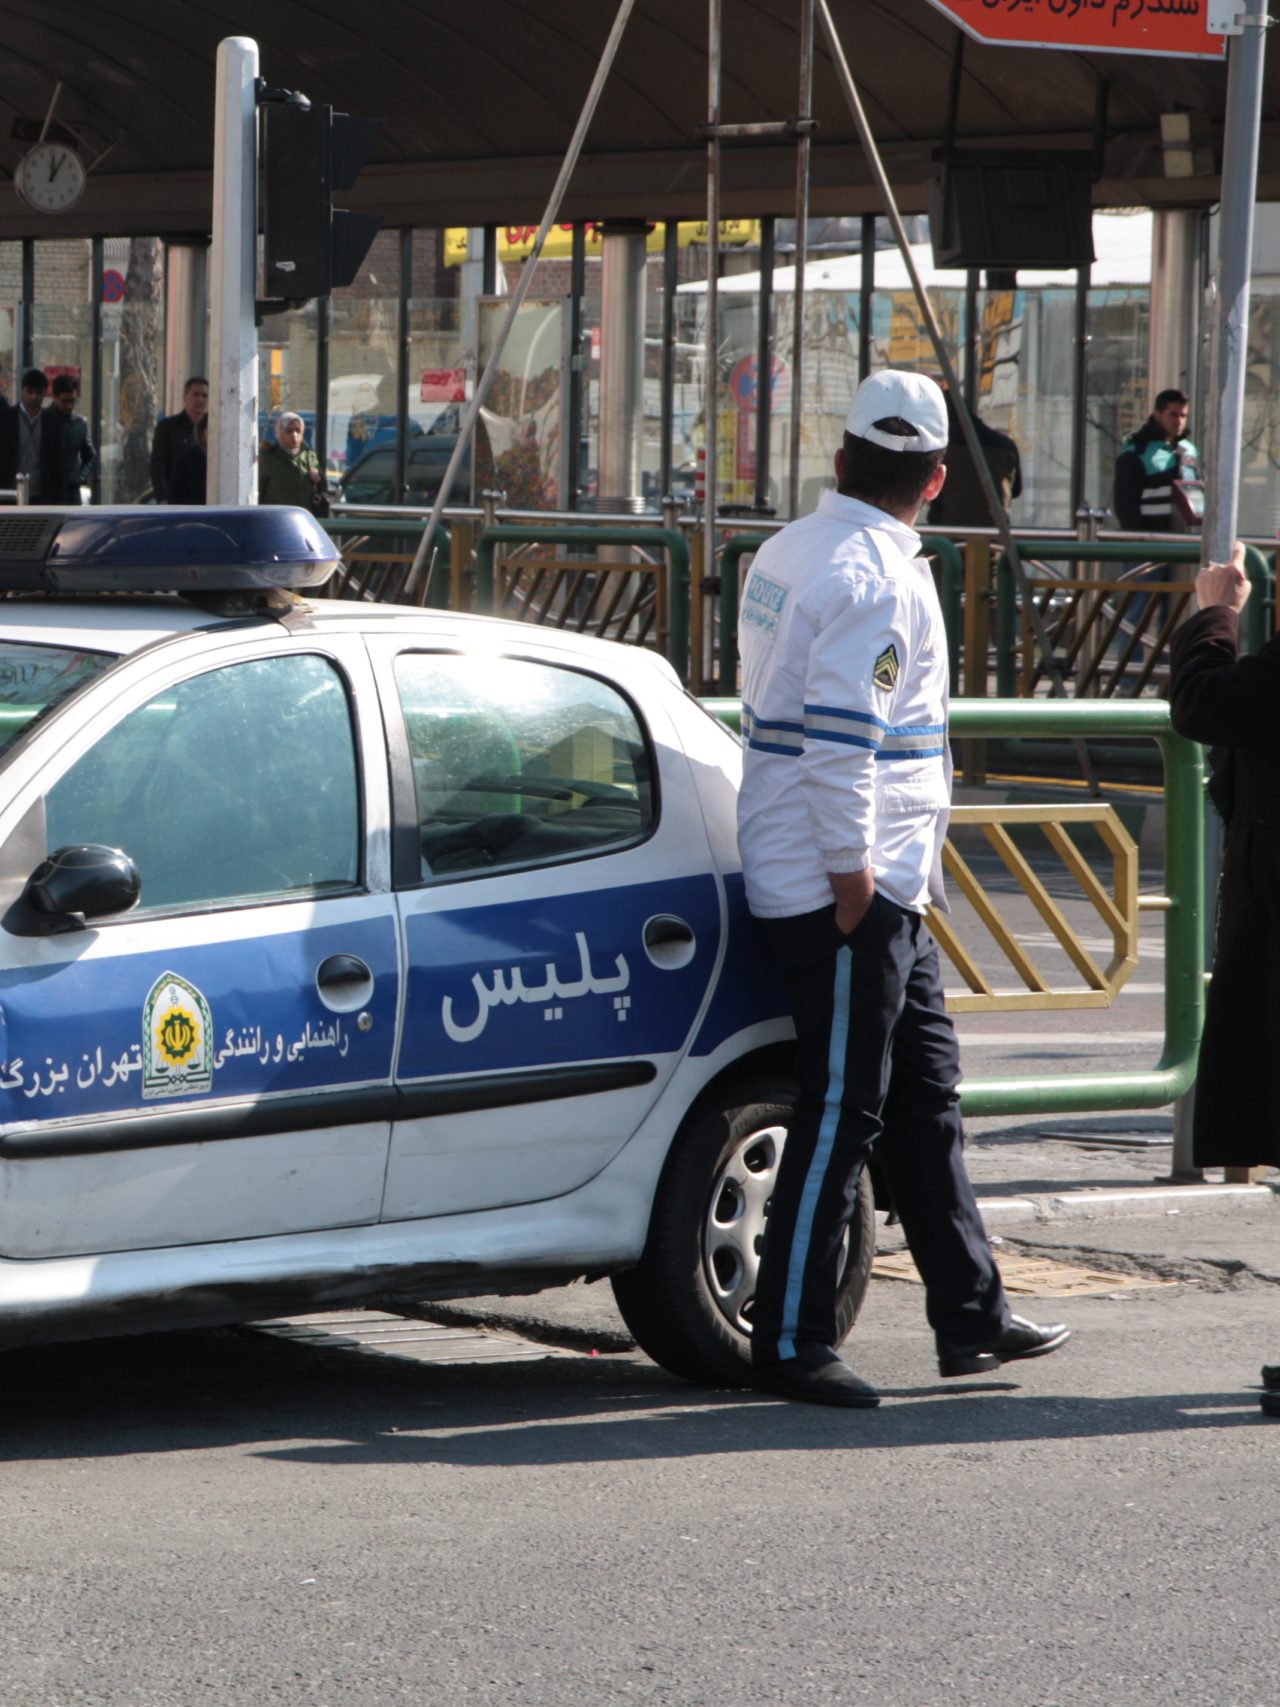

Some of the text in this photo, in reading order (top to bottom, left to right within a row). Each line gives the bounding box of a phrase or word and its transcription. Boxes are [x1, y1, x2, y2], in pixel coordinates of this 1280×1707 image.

[442, 932, 631, 1042] پلیس
[0, 1018, 349, 1098] راهنمایی و رانندگی تهران بزرگ
